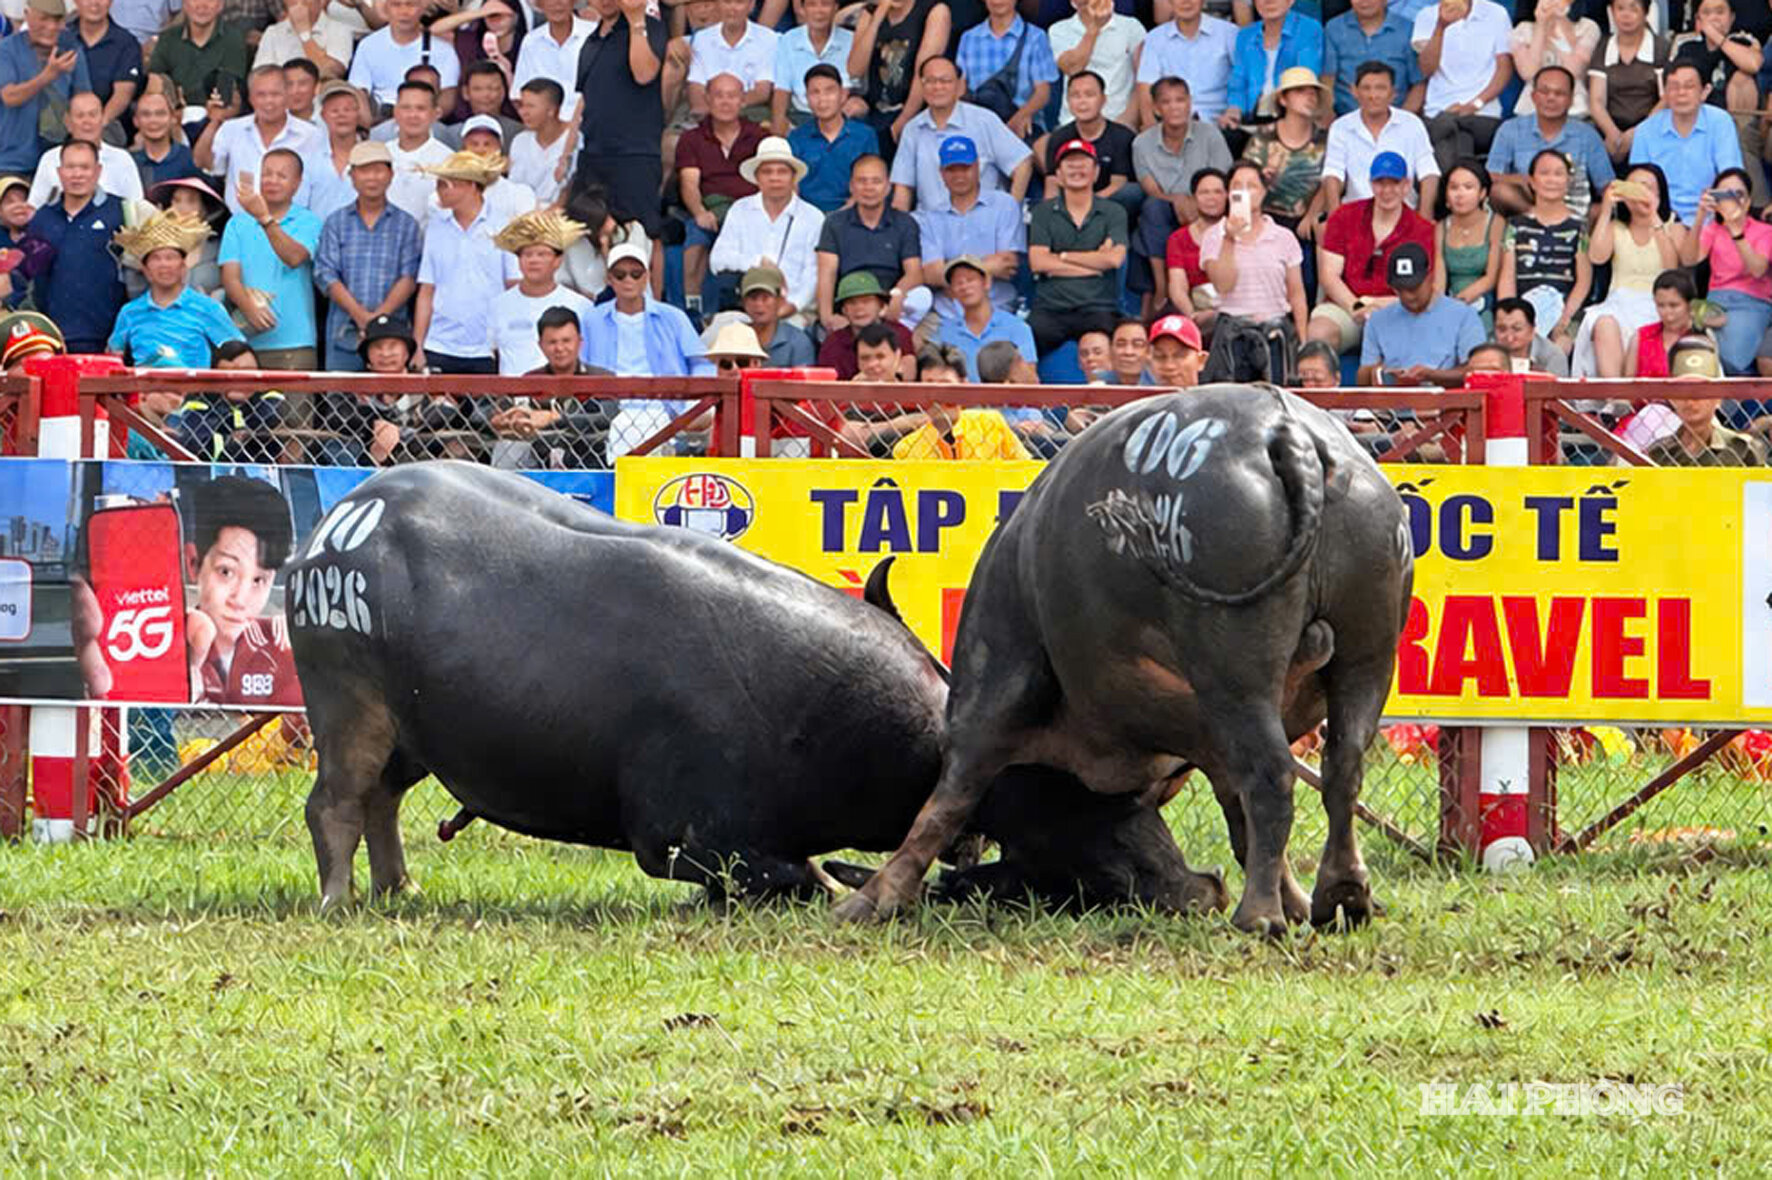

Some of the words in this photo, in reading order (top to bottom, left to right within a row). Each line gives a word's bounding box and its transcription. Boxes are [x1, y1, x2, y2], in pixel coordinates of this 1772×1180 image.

[1124, 410, 1229, 480] 06
[306, 498, 385, 559] 10
[1524, 480, 1630, 562] TẾ
[107, 606, 174, 662] 5G
[291, 565, 372, 634] 2026
[1397, 595, 1711, 700] RAVEL
